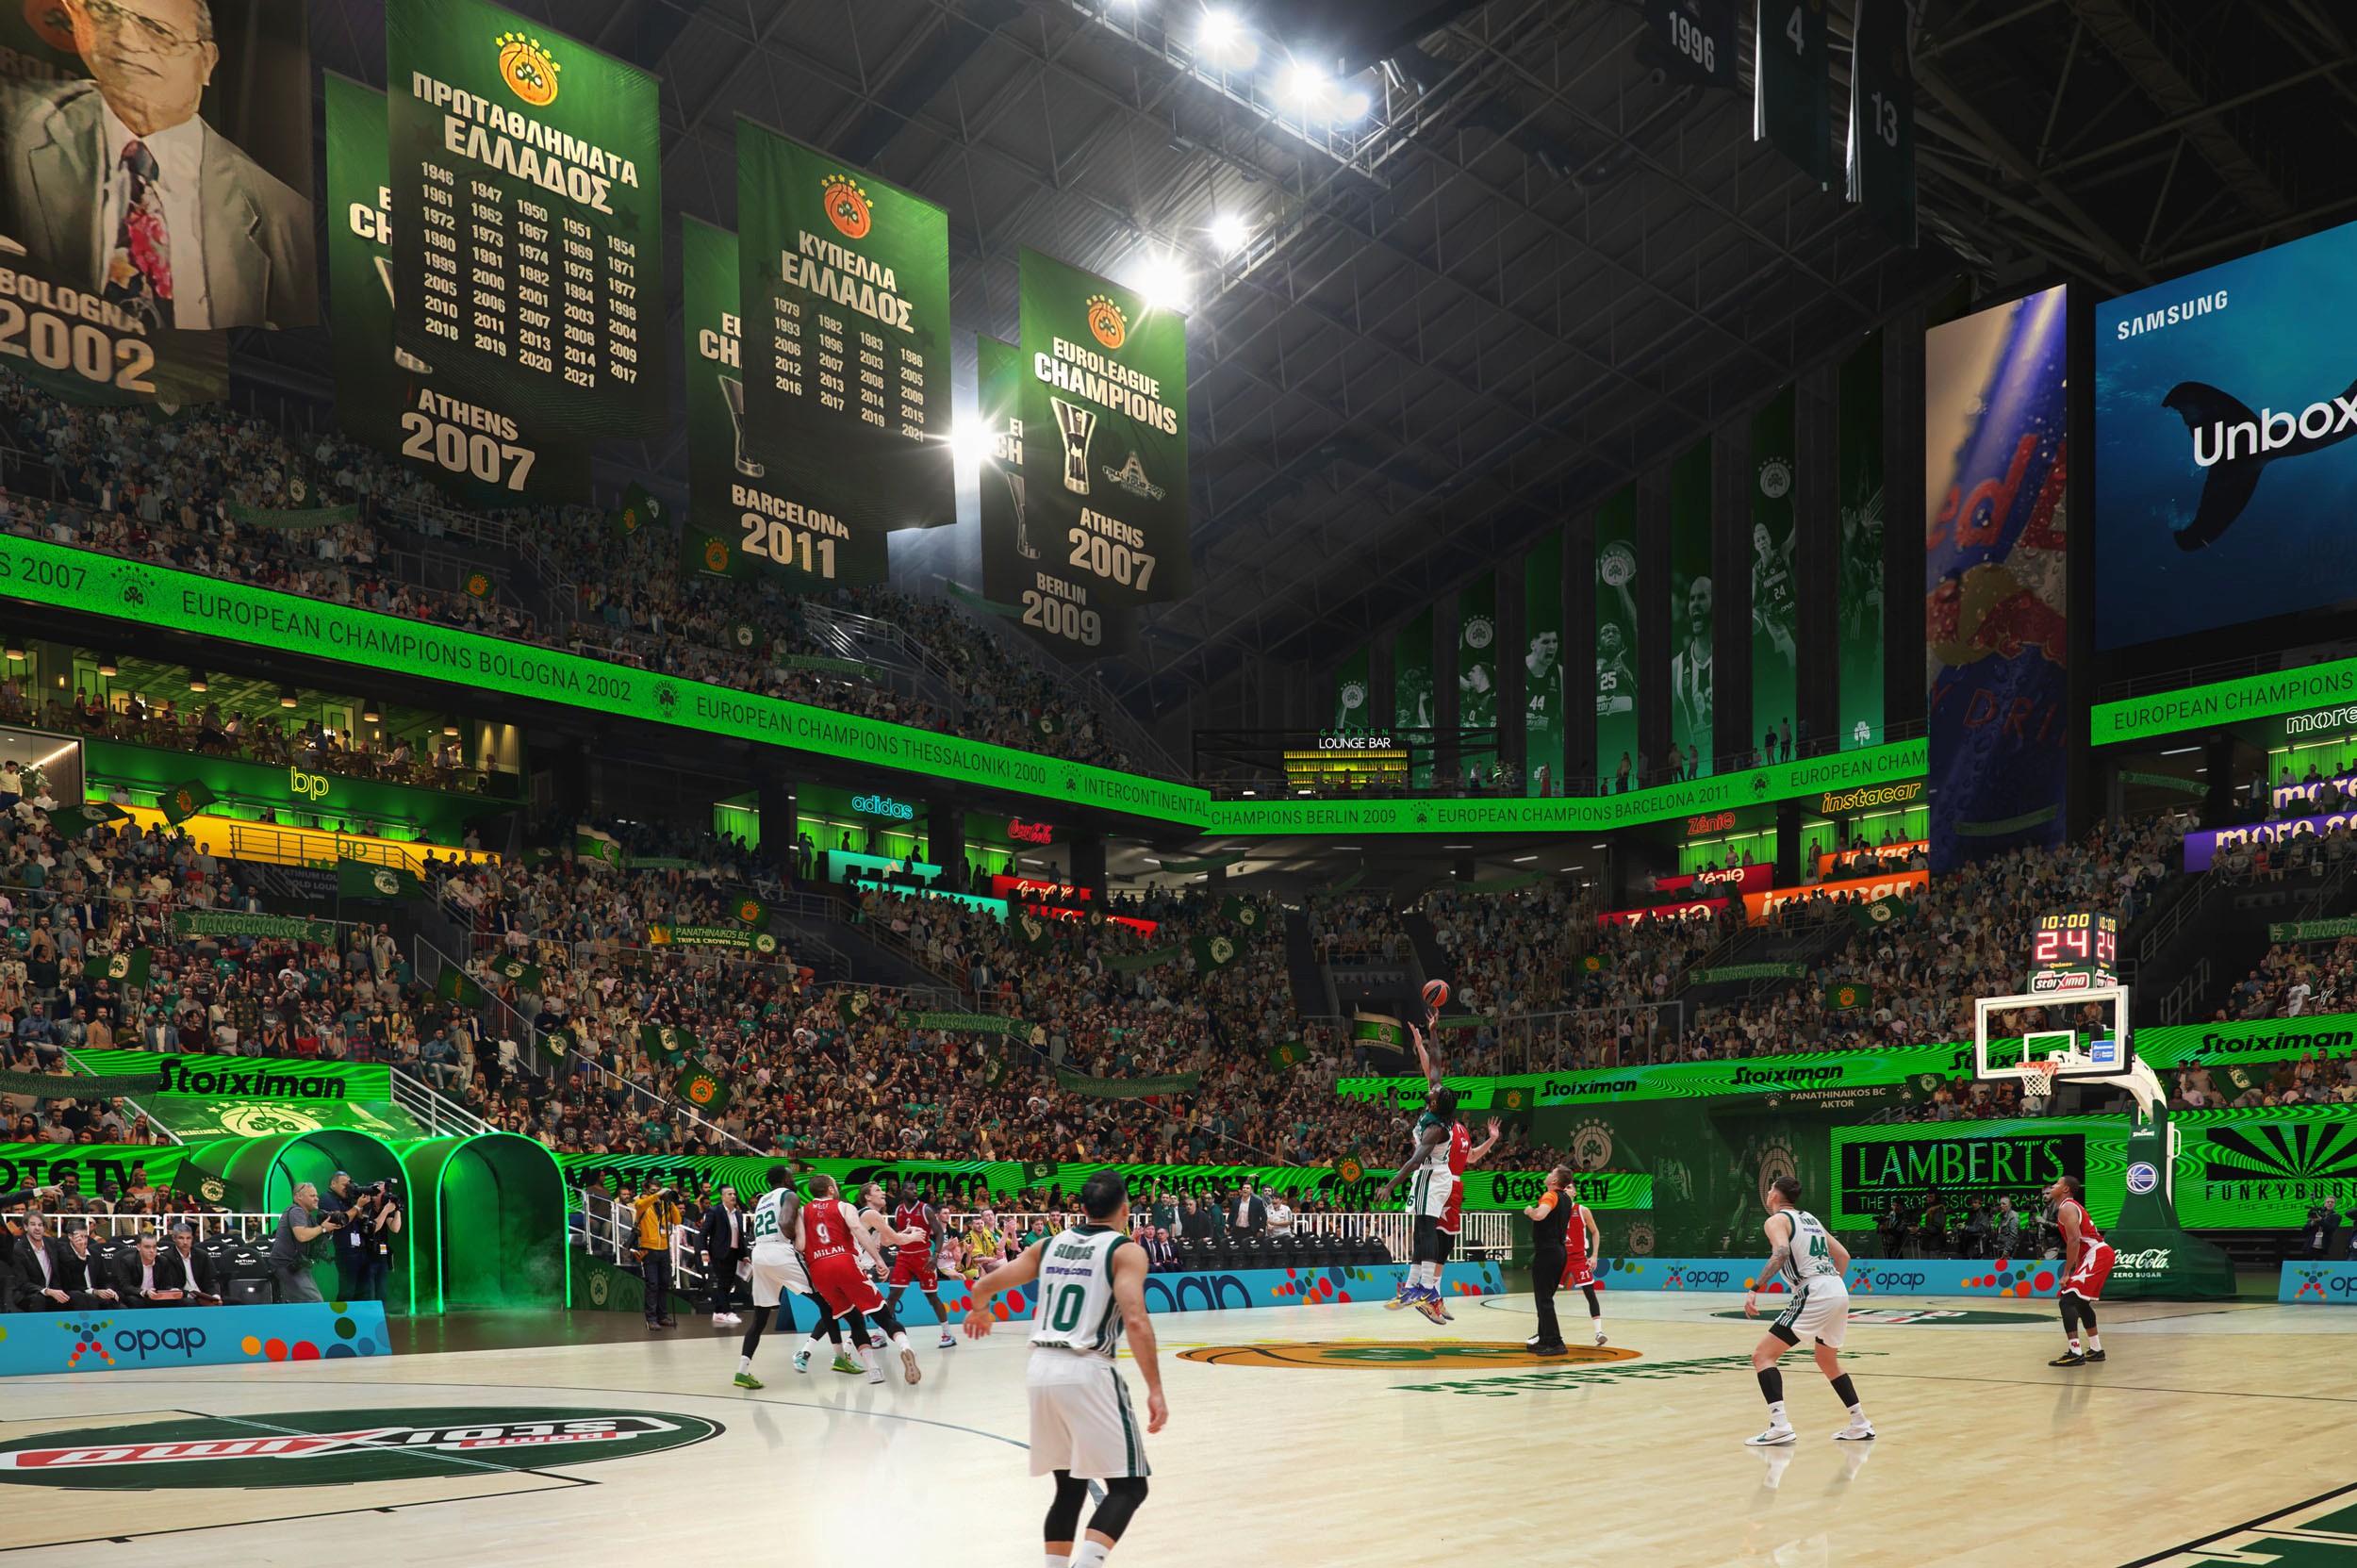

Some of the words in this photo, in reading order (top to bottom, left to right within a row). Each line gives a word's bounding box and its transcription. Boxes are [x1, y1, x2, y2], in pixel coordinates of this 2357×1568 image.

[1669, 10, 1715, 74] 1996
[1787, 6, 1805, 56] 4
[413, 71, 638, 189] ΠΡΩΤΑΘΛΗΜΑΤΑ
[1871, 91, 1898, 147] 13
[445, 114, 613, 215] ΕΛΛΑΔΟΣ
[421, 161, 453, 186] 1946
[470, 181, 503, 204] 1947
[517, 199, 547, 222] 1950
[563, 218, 592, 239] 1951
[607, 236, 635, 258] 1954
[422, 184, 453, 207] 1961
[471, 203, 503, 226] 1962
[518, 221, 548, 243] 1967
[563, 239, 593, 262] 1969
[608, 256, 635, 279] 1971
[423, 206, 455, 230] 1972
[471, 224, 503, 247] 1973
[518, 243, 549, 266] 1974
[564, 260, 593, 283] 1975
[608, 277, 635, 300] 1977
[424, 229, 456, 253] 1980
[472, 246, 503, 269] 1981
[519, 264, 550, 287] 1982
[564, 282, 594, 305] 1984
[609, 299, 636, 321] 1998
[799, 230, 898, 292] ΚΥΠΕΛΛΑ
[424, 251, 456, 274] 1999
[472, 268, 504, 290] 2000
[519, 285, 548, 308] 2001
[564, 303, 594, 325] 2003
[609, 319, 636, 342] 2004
[424, 272, 457, 297] 2005
[473, 290, 505, 313] 2006
[519, 307, 550, 329] 2007
[564, 324, 595, 346] 2008
[610, 340, 637, 363] 2009
[782, 249, 915, 334] ΕΛΛΑΔΟΣ
[2117, 289, 2229, 340] SAMSUNG
[425, 295, 458, 319] 2010
[474, 312, 504, 335] 2011
[519, 329, 551, 352] 2013
[565, 345, 596, 368] 2014
[611, 361, 637, 384] 2017
[425, 318, 458, 340] 2018
[474, 334, 506, 356] 2019
[519, 350, 552, 372] 2020
[565, 367, 595, 388] 2021
[773, 297, 799, 317] 1979
[818, 314, 843, 335] 1982
[860, 332, 883, 351] 1983
[900, 348, 922, 368] 1986
[774, 317, 800, 337] 1993
[818, 334, 844, 354] 1996
[860, 350, 883, 371] 2003
[900, 367, 923, 387] 2005
[775, 336, 800, 356] 2006
[819, 352, 844, 372] 2007
[860, 369, 884, 389] 2008
[900, 386, 923, 406] 2009
[775, 355, 801, 376] 2012
[819, 371, 844, 393] 2013
[861, 388, 884, 409] 2014
[901, 404, 924, 424] 2015
[1034, 352, 1178, 435] CHAMPIONS
[1053, 337, 1160, 400] EUROLEAGUE
[419, 388, 519, 441] ATHENS
[776, 375, 802, 396] 2016
[820, 391, 845, 411] 2017
[862, 407, 884, 428] 2019
[901, 423, 924, 443] 2021
[402, 412, 535, 491] 2007
[732, 484, 849, 540] BARCELONA
[1080, 507, 1145, 549] ATHENS
[741, 513, 835, 579] 2011
[1068, 527, 1155, 591] 2007
[1036, 571, 1086, 605] BERLIN
[1022, 590, 1101, 646] 2009
[22, 558, 87, 591] 2007
[183, 590, 320, 639] EUROPEAN
[329, 620, 471, 669] CHAMPIONS
[479, 652, 581, 692] BOLOGNA
[586, 674, 632, 701] 2002
[697, 696, 793, 734] EUROPEAN
[798, 718, 898, 755] CHAMPIONS
[902, 738, 1011, 778] THESSALONIKI
[1014, 762, 1046, 784] 2000
[1084, 776, 1211, 817] INTERCONTINENTAL
[2115, 697, 2217, 731] EUROPEAN
[2225, 671, 2353, 710] CHAMPIONS
[1319, 737, 1365, 750] LOUNGE
[1369, 737, 1391, 750] BAR
[1320, 728, 1389, 736] GARDEN
[290, 767, 329, 801] bp
[851, 795, 914, 820] adidas
[1211, 810, 1303, 826] CHAMPIONS
[1306, 809, 1360, 825] BERLIN
[1362, 808, 1396, 824] 2009
[1438, 808, 1518, 823] EUROPEAN
[1522, 803, 1612, 822] CHAMPIONS
[1615, 791, 1696, 818] BARCELONA
[1699, 784, 1729, 802] 2011
[1791, 761, 1872, 787] EUROPEAN
[1821, 783, 1921, 814] instacar
[676, 927, 735, 939] PANATHINAIKOS
[702, 938, 731, 947] CROWN
[2036, 930, 2087, 960] 24
[2041, 914, 2089, 929] 10:00
[2097, 932, 2116, 961] 24
[2099, 916, 2116, 933] 10:00
[2196, 1032, 2354, 1055] Stoiximan
[157, 1059, 346, 1099] Stoiximan
[1541, 1081, 1638, 1098] Stoiximan
[1731, 1065, 1843, 1085] Stoiximan
[1790, 1089, 1871, 1101] PANATHINAIKOS
[1873, 1087, 1887, 1097] BC
[1821, 1099, 1854, 1109] AKTOR
[1858, 1138, 2065, 1185] LAMBERTS
[755, 1210, 778, 1236] 22
[1860, 1197, 1885, 1211] THE
[814, 1246, 846, 1260] MILAN
[816, 1222, 831, 1245] 9
[1687, 1268, 1729, 1288] opap
[1875, 1273, 1925, 1290] opap
[1043, 1283, 1085, 1331] 10
[115, 1325, 206, 1360] opap
